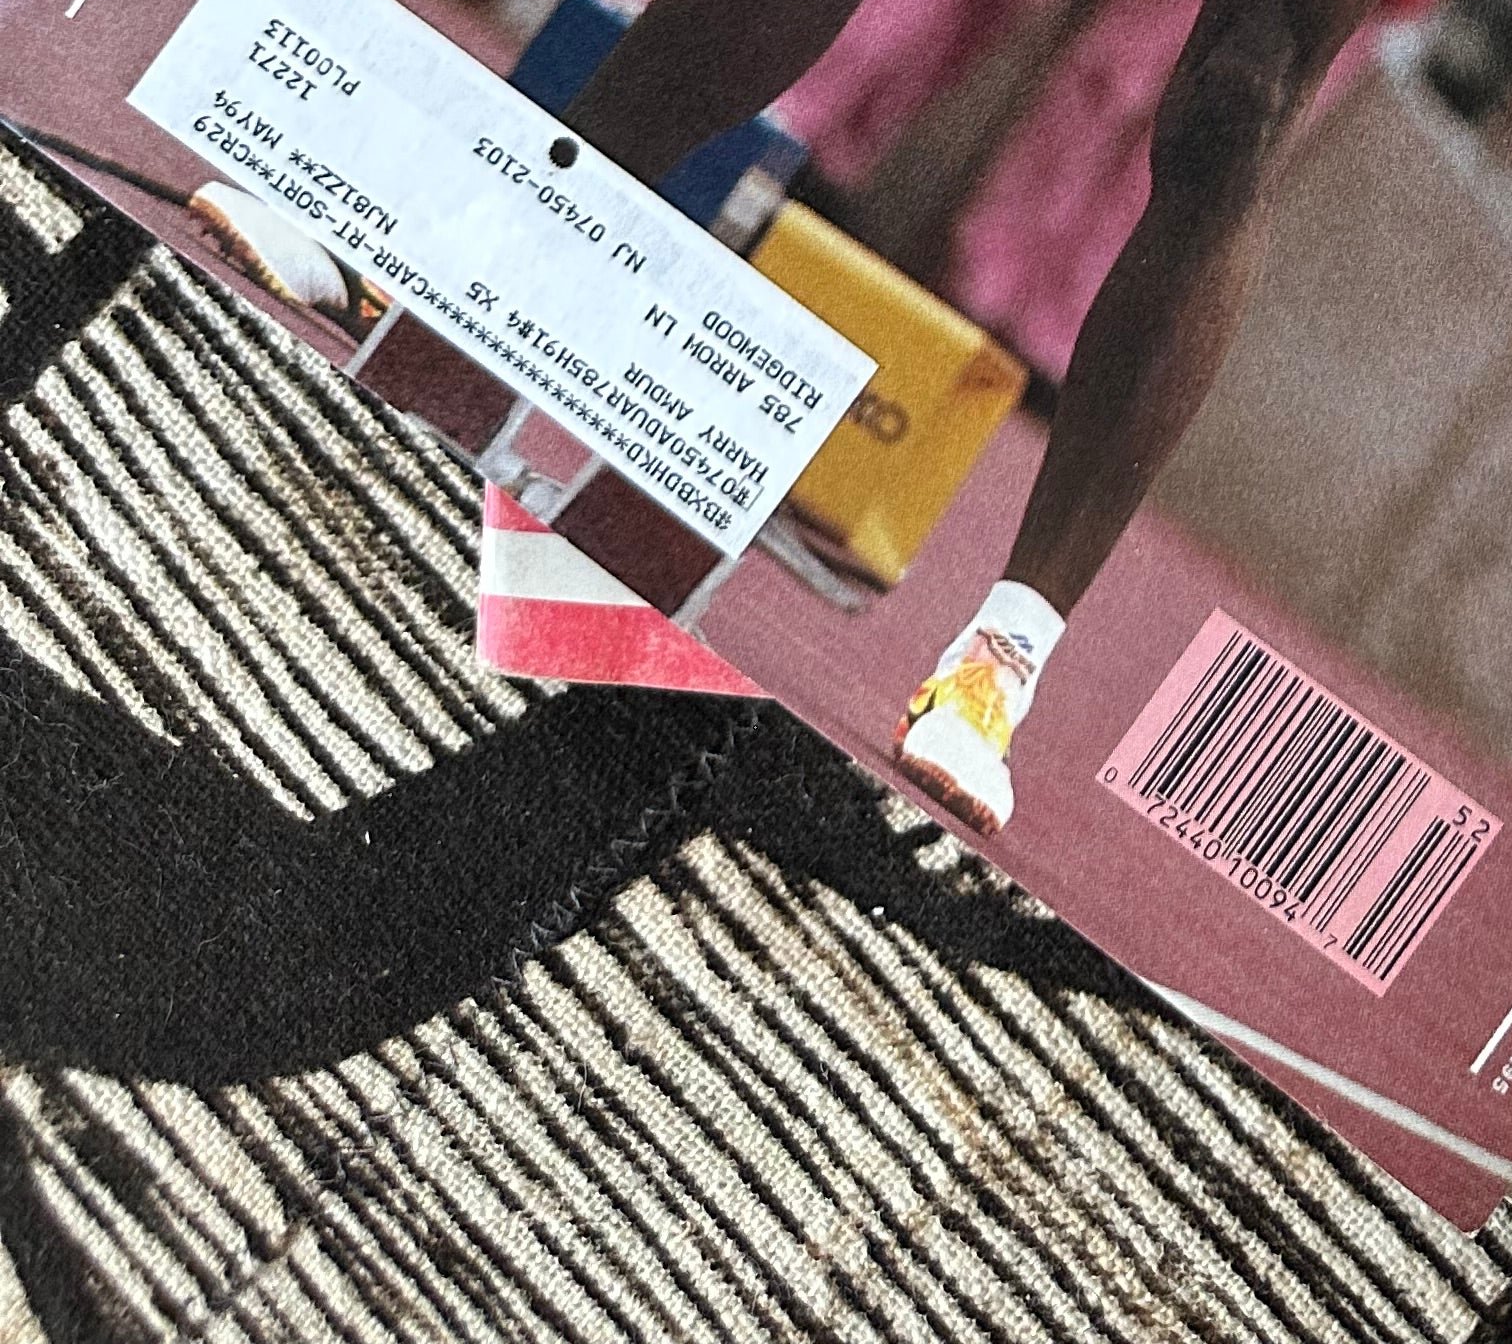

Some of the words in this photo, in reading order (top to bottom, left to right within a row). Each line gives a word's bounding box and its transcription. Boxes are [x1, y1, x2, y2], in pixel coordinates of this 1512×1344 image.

[248, 41, 318, 101] 12271
[213, 90, 284, 150] MAY94
[473, 137, 606, 243] 07450-2103
[611, 242, 647, 274] NJ
[465, 281, 500, 313] X5
[644, 304, 678, 337] LN
[682, 333, 756, 393] ARROW
[702, 311, 824, 409] RIDGEWOOD
[623, 362, 694, 422] AMDUR
[758, 394, 803, 434] 785
[698, 425, 769, 483] HARRY
[1103, 767, 1119, 786] 0
[1145, 792, 1222, 863] 72440
[1230, 855, 1302, 925] 10094
[1322, 931, 1339, 951] 7
